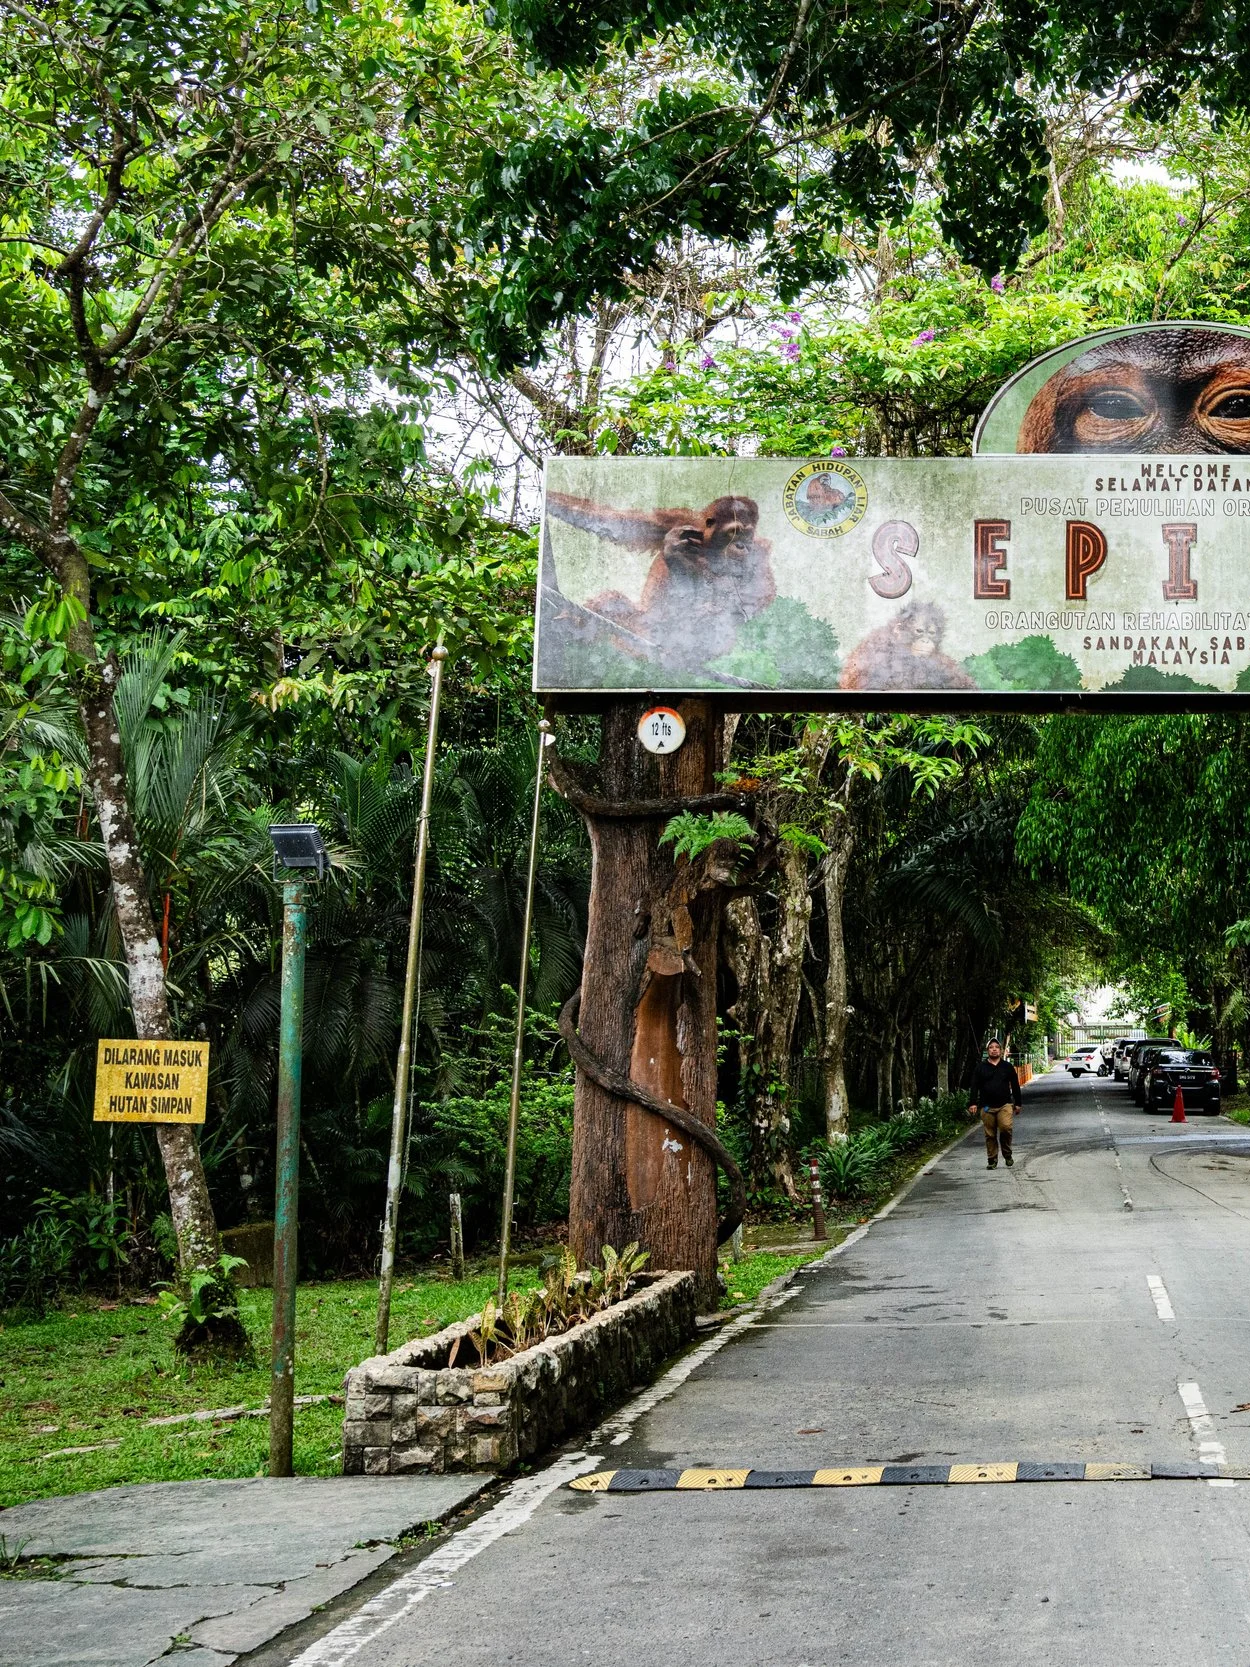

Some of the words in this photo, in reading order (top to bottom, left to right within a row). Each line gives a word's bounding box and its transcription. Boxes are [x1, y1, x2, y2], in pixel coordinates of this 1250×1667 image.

[1141, 463, 1232, 478] WELCOME
[785, 471, 806, 522] JABATAN
[812, 462, 863, 489] HIDUPAN
[849, 496, 866, 523] LIAR
[1095, 477, 1183, 492] SELAMAT
[1020, 497, 1089, 515] PUSAT
[1096, 497, 1216, 517] PEMULIHAN
[806, 526, 844, 537] SABAH
[985, 610, 1116, 631] ORANGUTAN
[1133, 650, 1231, 665] MALAYSIA
[651, 722, 658, 736] 12
[661, 722, 671, 736] fts
[104, 1048, 160, 1066] DILARANG
[163, 1049, 203, 1067] MASUK
[125, 1072, 180, 1090] KAWASAN
[109, 1095, 148, 1113] HUTAN
[150, 1097, 192, 1114] SIMPAN
